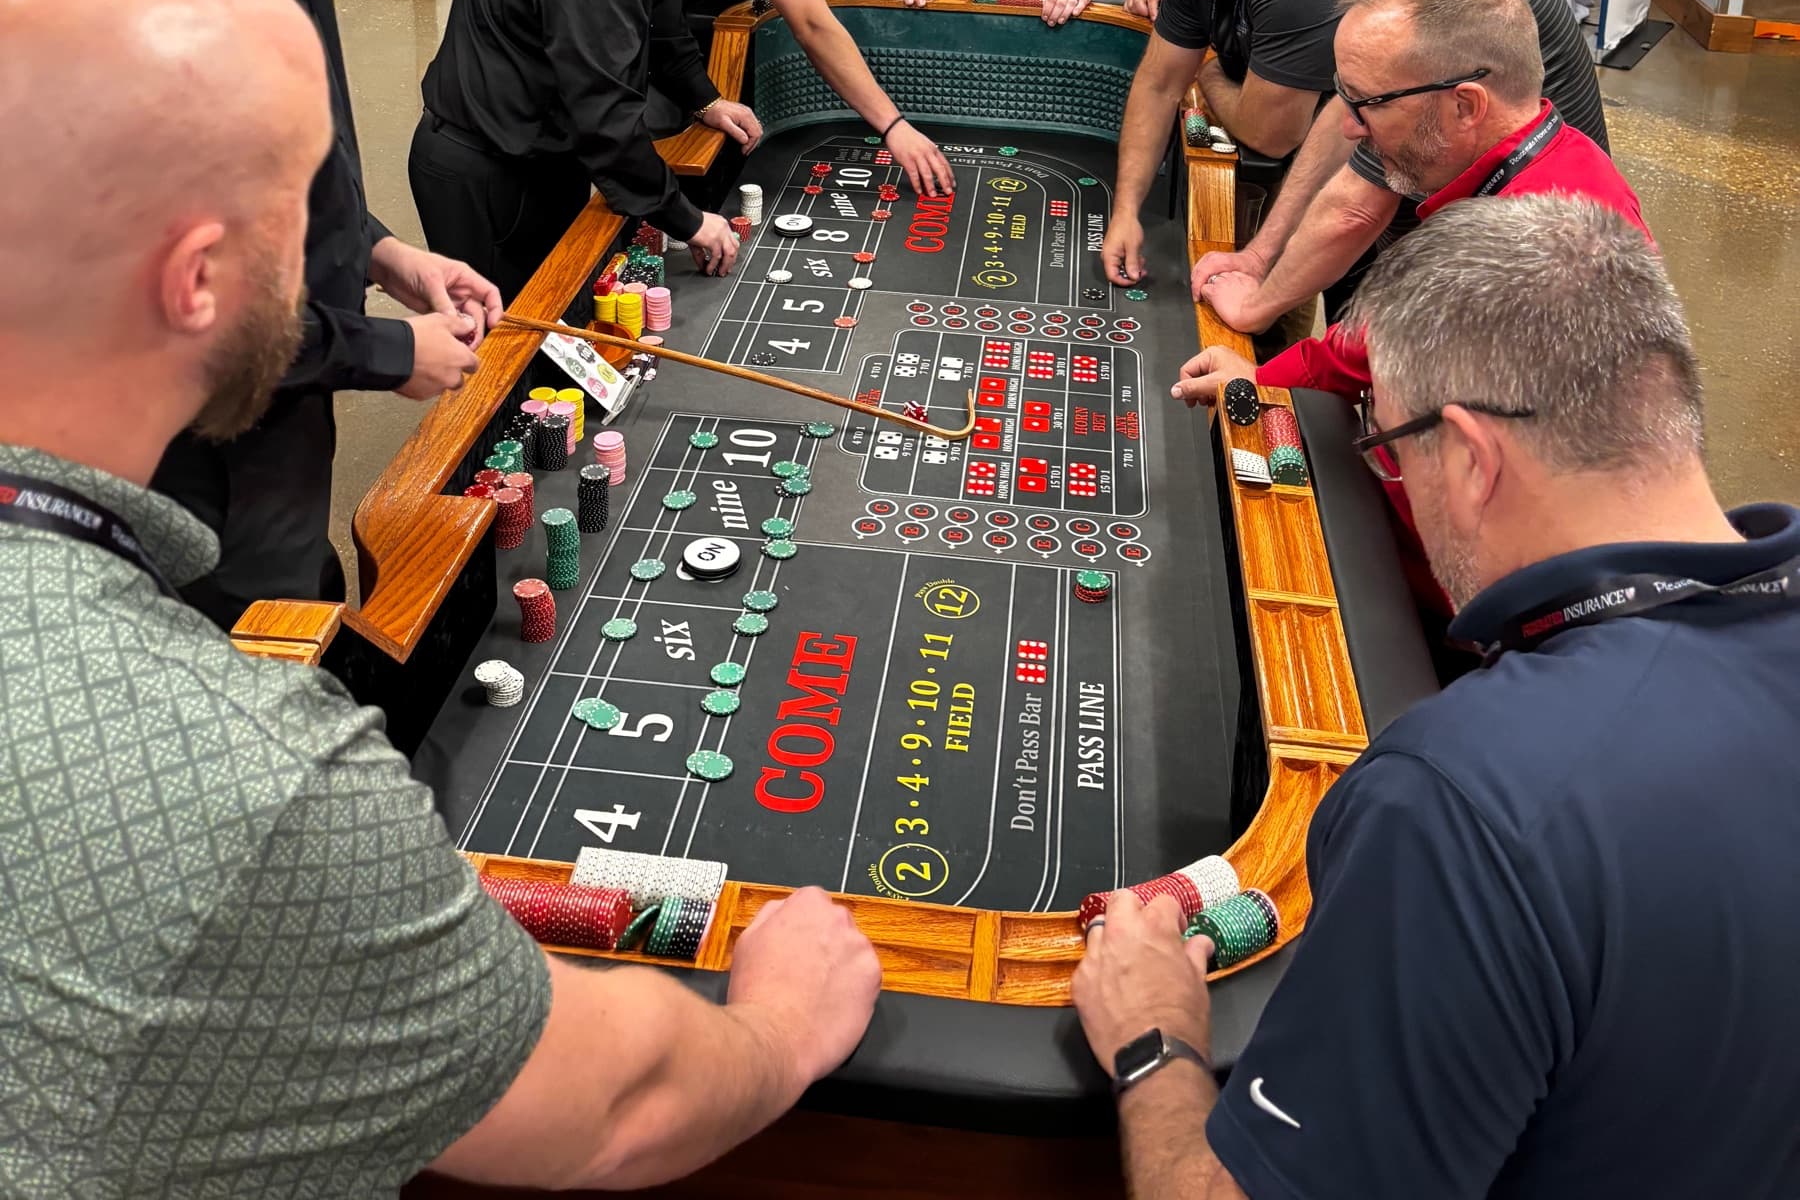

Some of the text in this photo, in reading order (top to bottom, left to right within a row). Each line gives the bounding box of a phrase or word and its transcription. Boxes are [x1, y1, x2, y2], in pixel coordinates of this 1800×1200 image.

[943, 145, 984, 154] PASS
[835, 168, 873, 188] 10
[999, 180, 1020, 191] 12
[830, 193, 859, 218] nine
[992, 196, 1012, 207] 11
[904, 191, 956, 253] COM
[986, 212, 1006, 225] 10
[1010, 214, 1027, 240] FIELD
[1088, 213, 1104, 251] PASS LINE
[812, 229, 850, 242] 8
[1050, 219, 1067, 268] Don't Pass Bar
[803, 257, 833, 278] six
[782, 299, 824, 313] 5
[768, 338, 811, 355] 4
[1007, 377, 1020, 409] HORN HIGH
[1122, 390, 1132, 398] TO
[1053, 412, 1064, 420] TO
[1074, 406, 1088, 436] HORN
[1092, 412, 1106, 432] BET
[1053, 420, 1063, 429] 30
[1116, 416, 1127, 434] ANY
[1126, 411, 1138, 440] CRAPS
[853, 430, 864, 440] TO
[1002, 418, 1015, 452] HORN HIGH
[721, 428, 778, 469] 10
[902, 442, 913, 451] TO
[951, 446, 961, 455] TO
[1123, 454, 1134, 462] TO
[998, 462, 1011, 500] HORN HIGH
[1050, 472, 1061, 480] TO
[1100, 474, 1110, 484] TO
[1050, 481, 1061, 489] 15
[1100, 485, 1111, 494] 15
[711, 479, 749, 532] nine
[873, 504, 889, 513] C
[913, 508, 928, 517] C
[953, 512, 969, 521] C
[994, 515, 1009, 524] C
[1034, 519, 1050, 528] C
[860, 522, 876, 531] E
[903, 527, 919, 536] E
[1074, 523, 1090, 532] C
[1116, 528, 1131, 537] C
[947, 531, 963, 541] E
[991, 535, 1007, 544] E
[1035, 540, 1051, 549] E
[1080, 544, 1097, 554] E
[697, 542, 727, 562] ON
[1125, 548, 1141, 557] E
[934, 588, 968, 616] 12
[1563, 589, 1626, 622] INSURANCE
[653, 618, 696, 662] six
[754, 631, 859, 815] COME
[945, 682, 975, 753] FIELD
[609, 711, 674, 743] 5
[895, 633, 953, 835] 3 4 9 10 11
[1077, 682, 1105, 790] PASS LINE
[1010, 693, 1042, 833] Don't Pass Bar
[573, 803, 642, 844] 4
[868, 863, 887, 893] Double
[896, 862, 931, 881] 2
